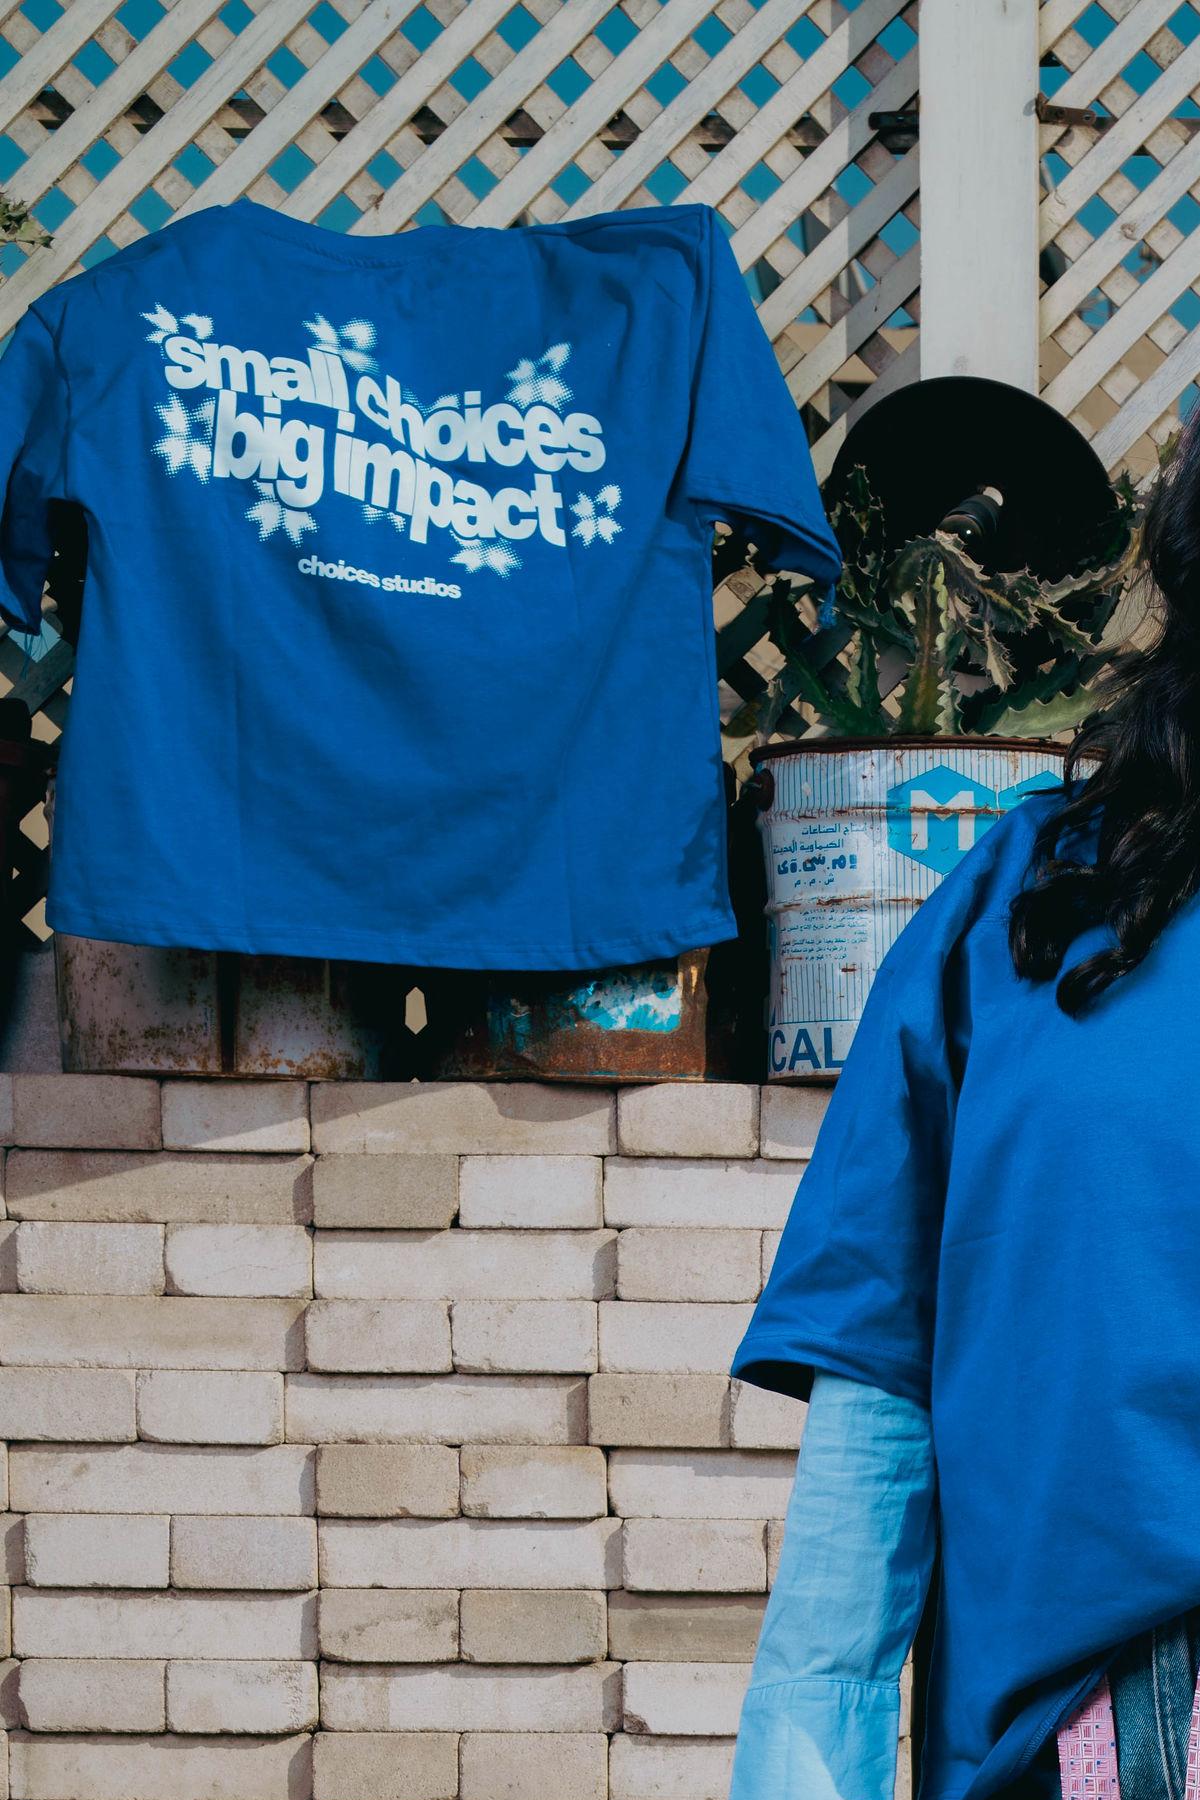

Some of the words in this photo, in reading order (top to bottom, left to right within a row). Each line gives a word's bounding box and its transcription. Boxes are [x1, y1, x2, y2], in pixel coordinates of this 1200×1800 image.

[163, 333, 349, 412] small
[356, 374, 607, 473] choices
[212, 389, 324, 508] big
[333, 411, 567, 548] impact
[298, 555, 381, 589] choices
[381, 573, 462, 599] studios
[768, 1027, 847, 1073] CAL
